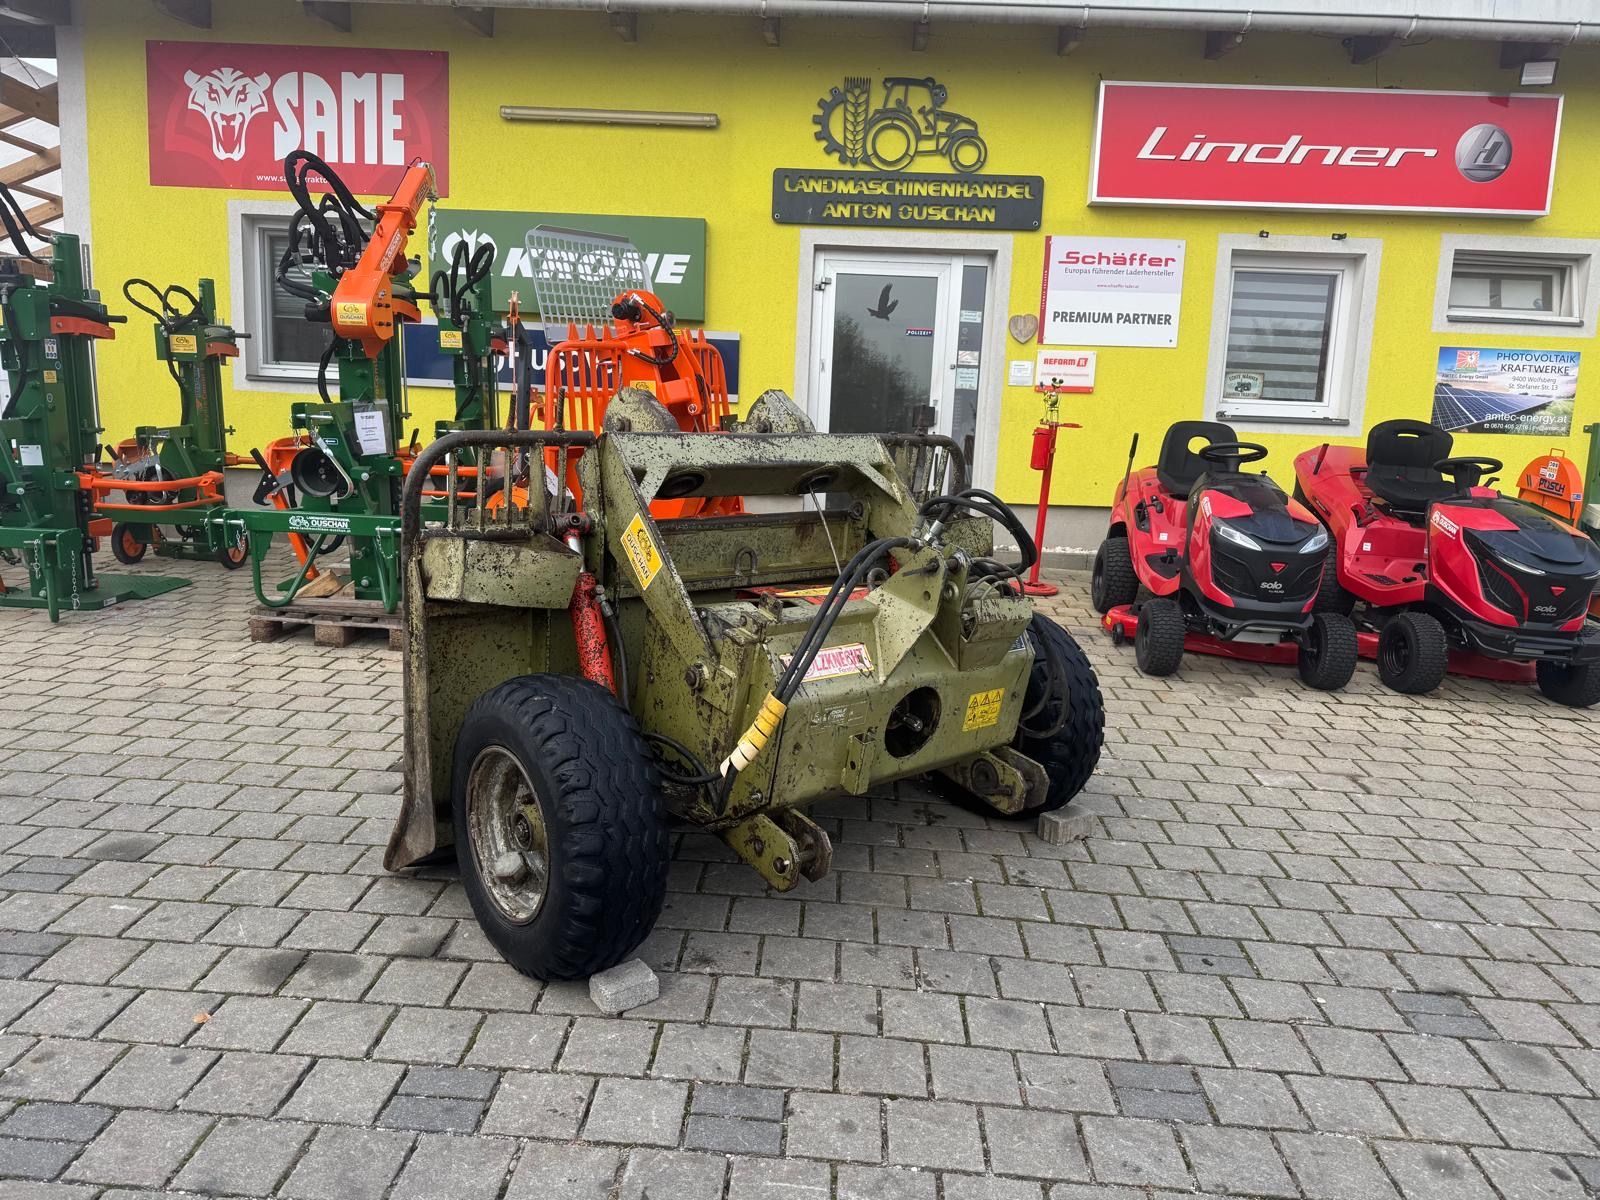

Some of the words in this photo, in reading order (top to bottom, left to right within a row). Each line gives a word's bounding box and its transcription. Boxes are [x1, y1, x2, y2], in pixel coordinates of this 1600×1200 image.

[273, 71, 405, 166] SAME
[1136, 126, 1438, 168] Lindner
[783, 175, 1035, 200] LANDMASCHINENHANDEL
[822, 201, 892, 220] ANTON
[898, 204, 996, 223] OUSCHAN
[1058, 251, 1177, 267] Schäffer
[501, 247, 691, 284] KRONE
[1064, 267, 1091, 275] Europas
[1092, 267, 1125, 276] führender
[1126, 269, 1175, 277] Laderhersteller
[1053, 311, 1113, 324] PREMIUM
[1116, 313, 1172, 325] PARTNER
[1043, 358, 1076, 366] REFORM
[1496, 352, 1576, 363] PHOTOVOLTAIK
[1500, 363, 1570, 374] KRAFTWERKE
[1528, 376, 1557, 384] Wolfsberg
[1485, 412, 1567, 424] amtec-energy.at
[310, 519, 349, 529] OUSCHAN
[626, 532, 650, 580] OUSCHAN
[1260, 581, 1283, 590] solo
[1534, 605, 1557, 613] solo
